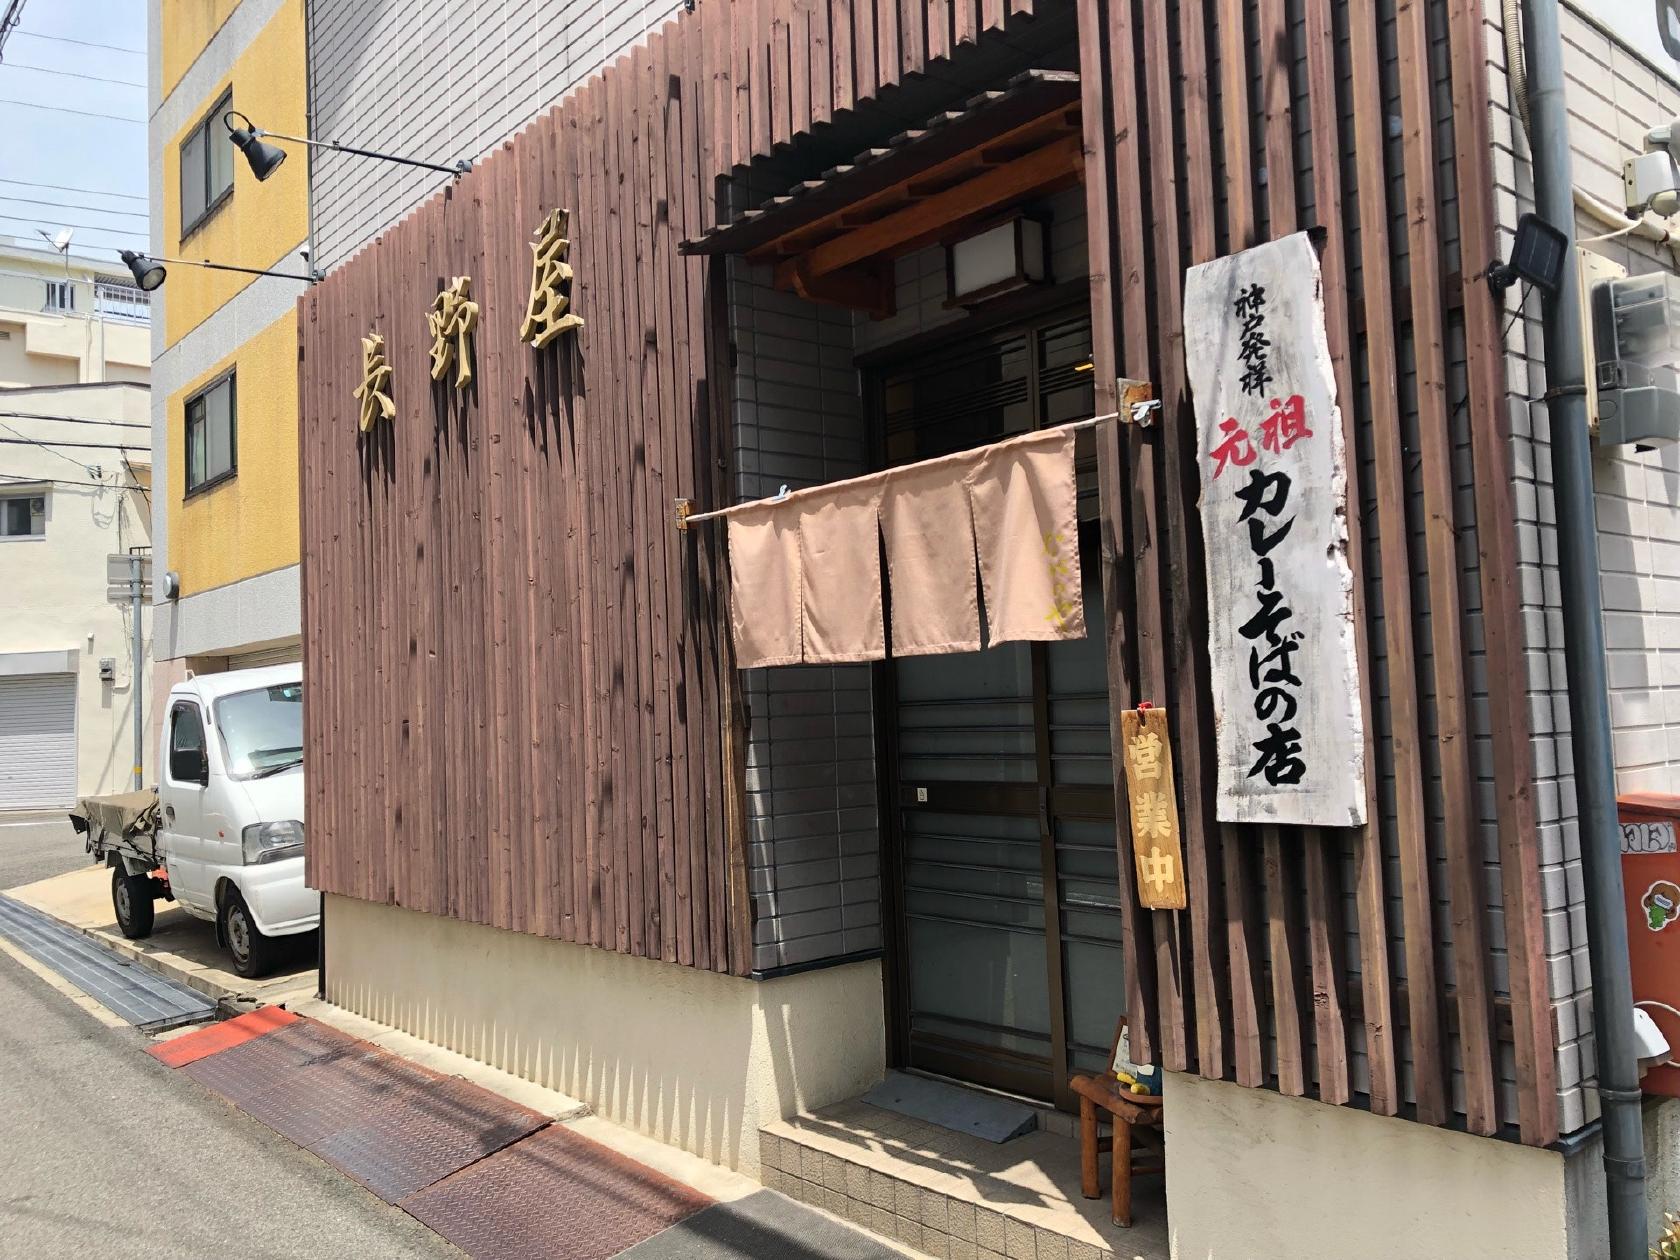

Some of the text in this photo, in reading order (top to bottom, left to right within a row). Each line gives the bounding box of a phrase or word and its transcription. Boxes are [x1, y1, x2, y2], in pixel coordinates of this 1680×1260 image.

[352, 208, 585, 432] 長野屋
[1234, 283, 1274, 399] 神戸発祥
[1209, 394, 1314, 481] 元祖
[1235, 469, 1307, 787] カレーそばの店
[1128, 731, 1175, 894] 営業中
